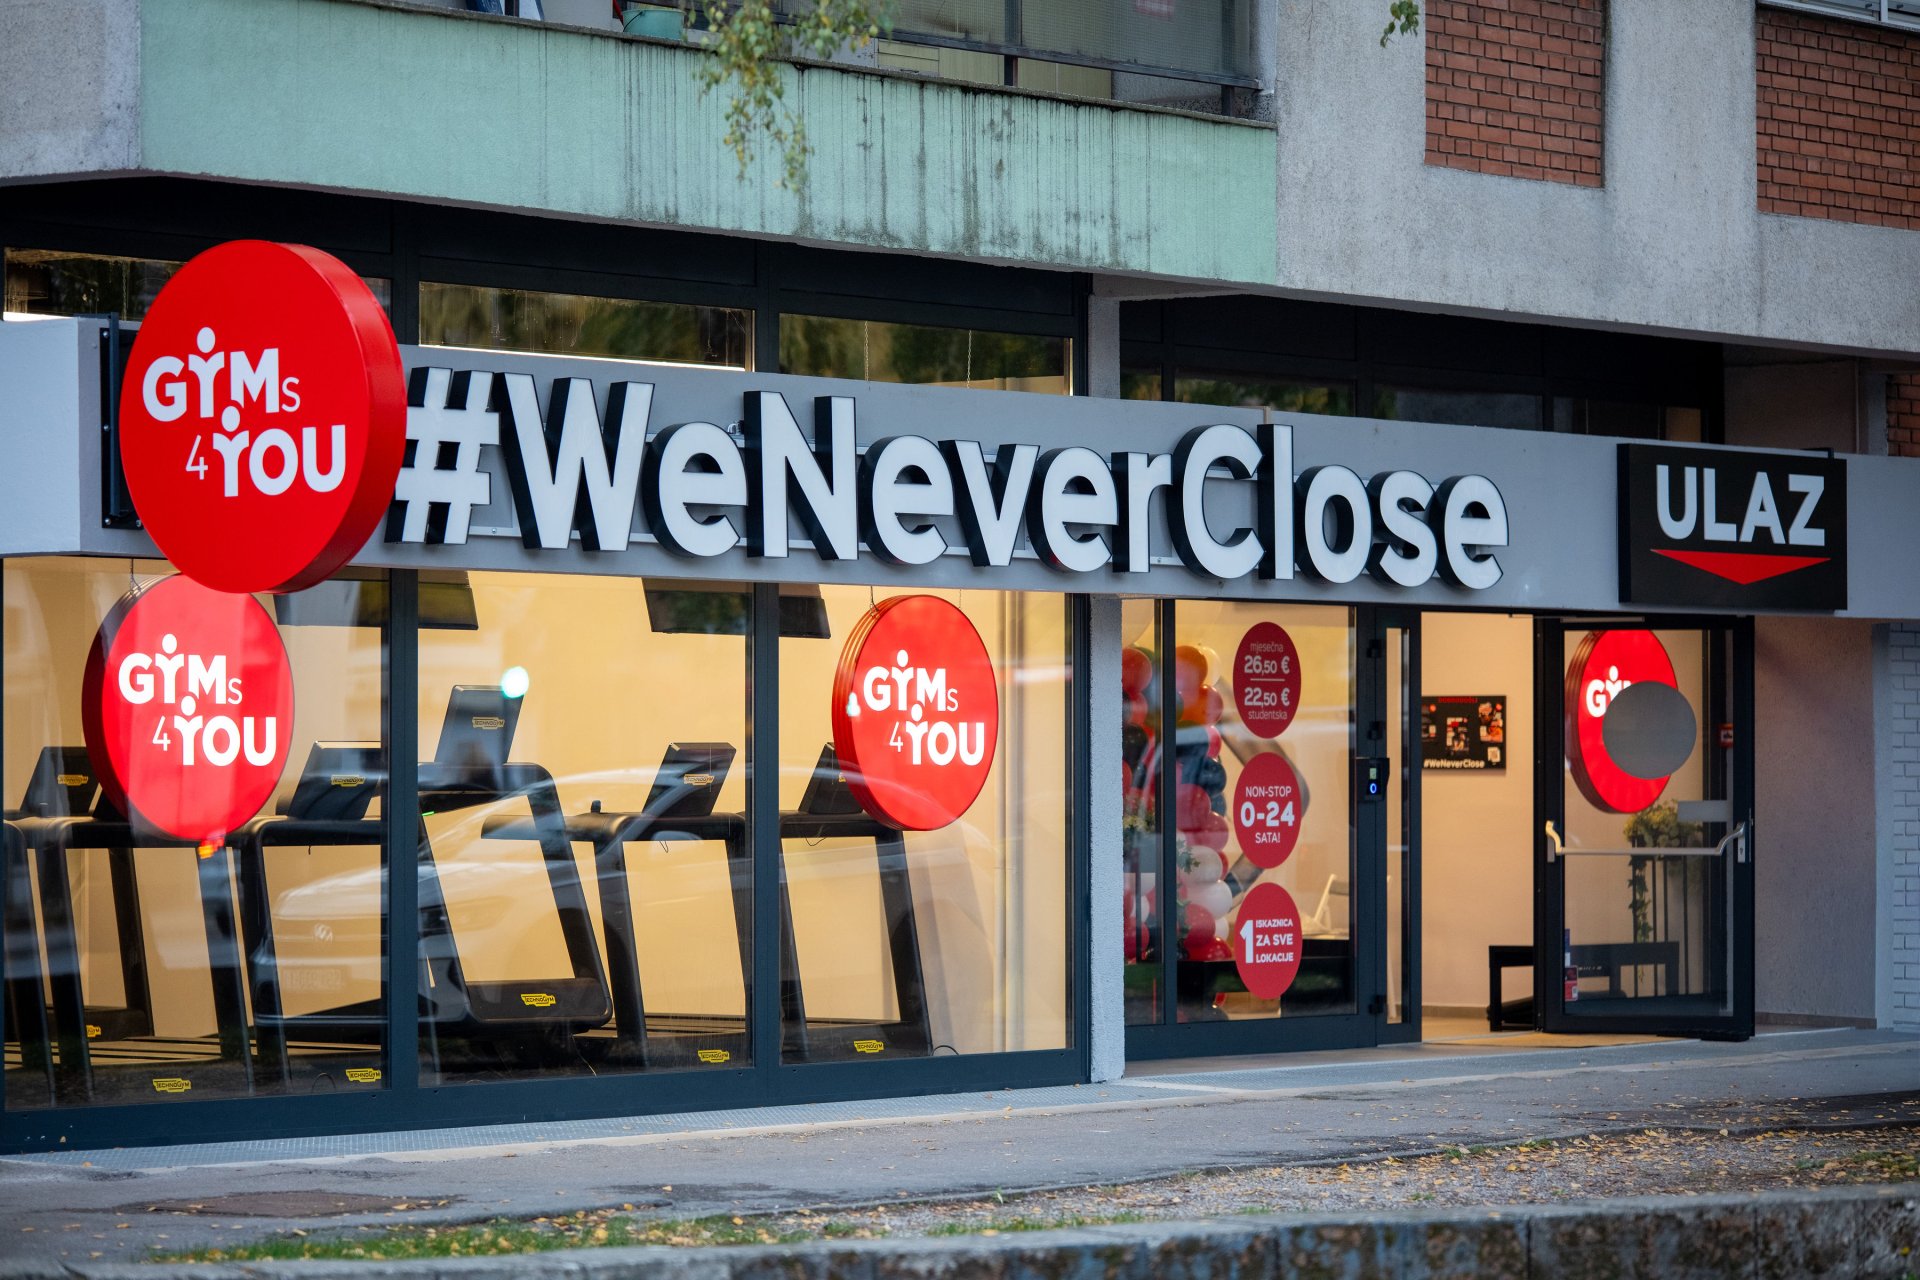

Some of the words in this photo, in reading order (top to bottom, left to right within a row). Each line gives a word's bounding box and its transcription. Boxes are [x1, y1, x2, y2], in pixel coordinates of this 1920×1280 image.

[387, 364, 1511, 592] #WeNeverClose
[1656, 464, 1826, 547] ULAZ
[1250, 641, 1284, 654] mjesečna
[1281, 655, 1291, 675] €
[1281, 687, 1291, 707] €
[1248, 709, 1287, 720] studentska
[1423, 759, 1485, 769] #WeNeverClose
[1245, 786, 1292, 798] NON-STOP
[1240, 801, 1295, 828] 0-24
[1255, 832, 1281, 844] SATA!
[1240, 919, 1254, 964] 1
[1256, 918, 1293, 928] ISKAZNICA
[1256, 935, 1271, 947] ZA
[1273, 933, 1293, 946] SVE
[1256, 952, 1294, 964] LOKACIJE
